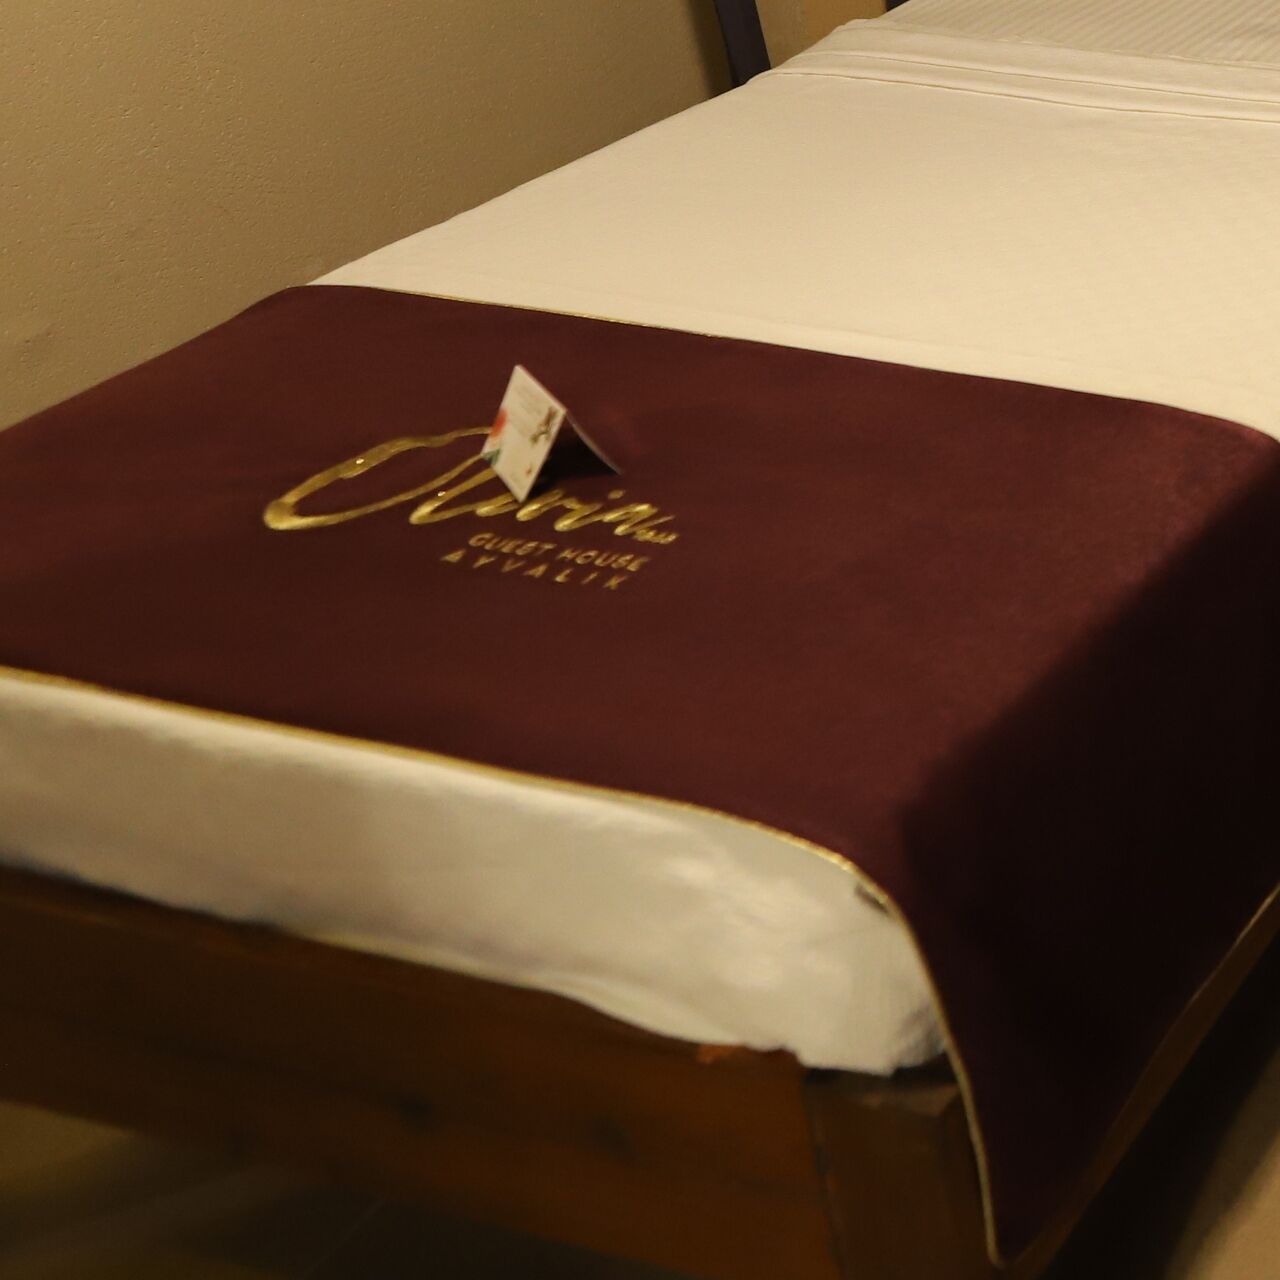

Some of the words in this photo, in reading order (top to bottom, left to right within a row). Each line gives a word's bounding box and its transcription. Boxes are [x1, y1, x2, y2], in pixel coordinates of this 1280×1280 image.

[439, 548, 630, 591] AYVALIK
[467, 531, 557, 557] GUEST
[555, 547, 651, 573] HOUSE
